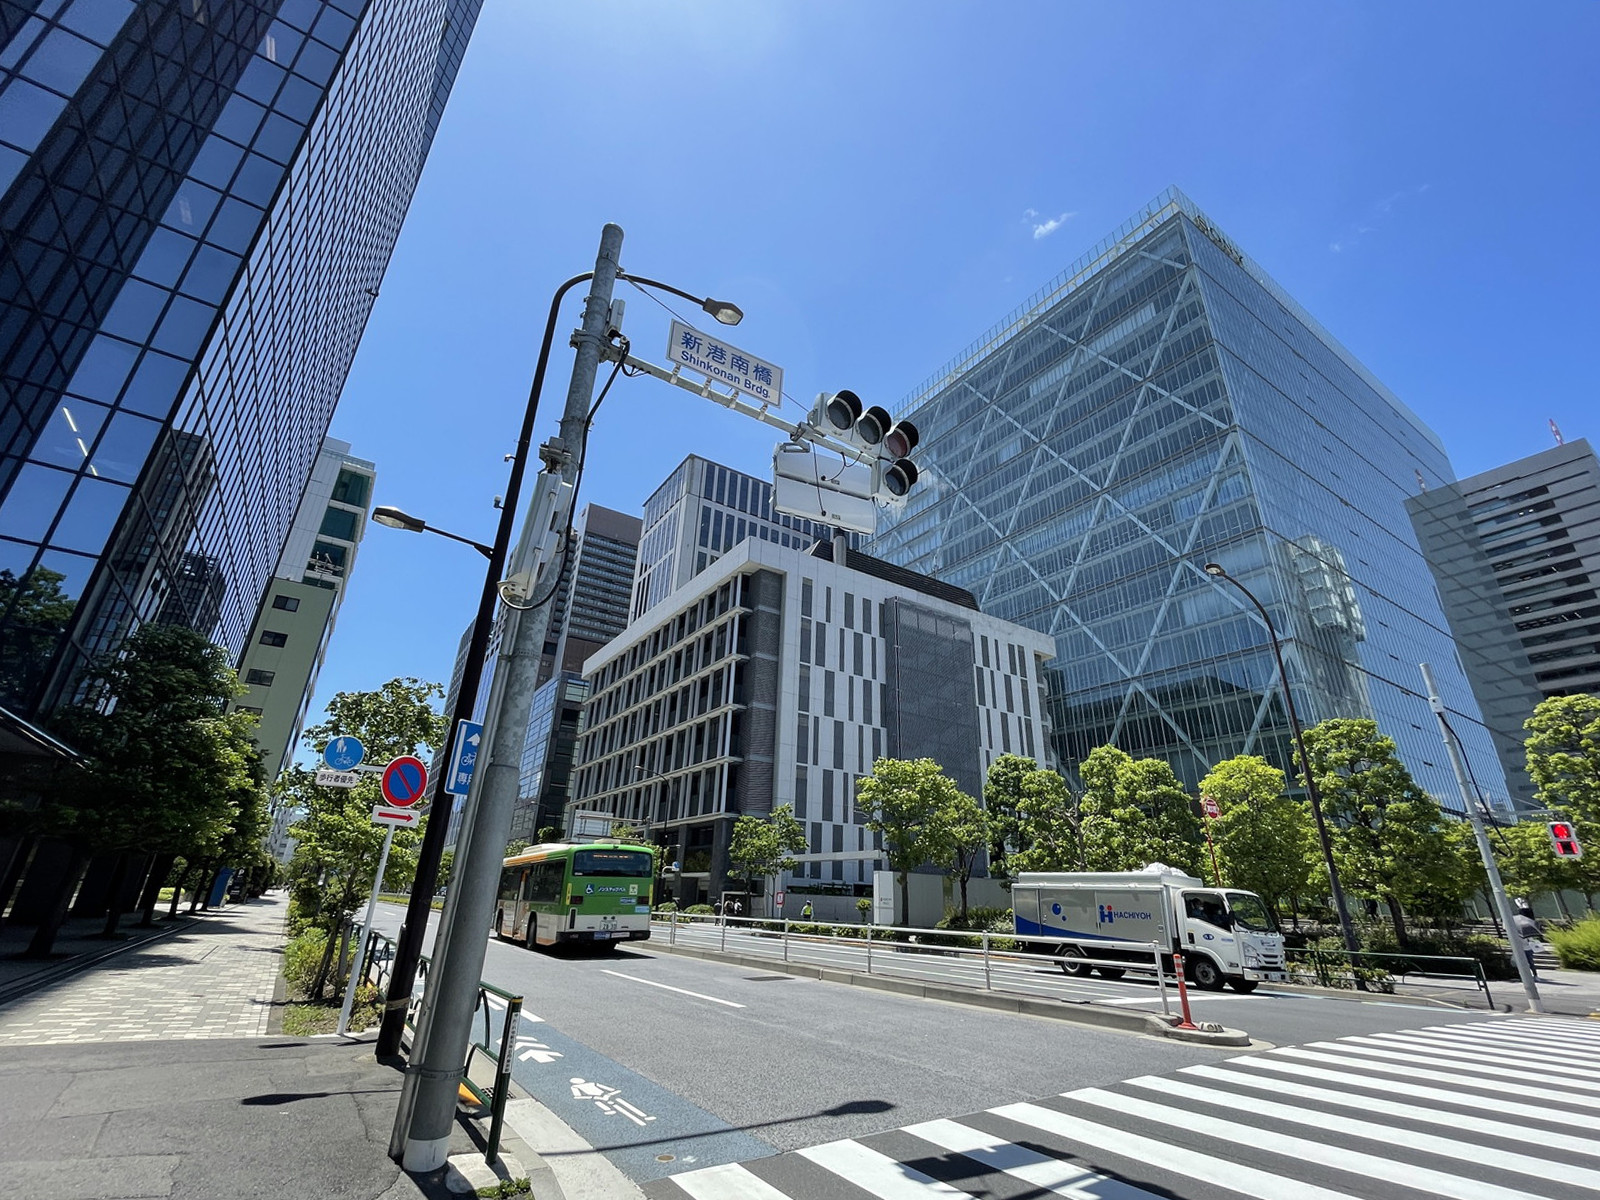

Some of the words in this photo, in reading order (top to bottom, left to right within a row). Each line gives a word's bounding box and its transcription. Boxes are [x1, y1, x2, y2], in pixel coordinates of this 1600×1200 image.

[681, 331, 773, 386] 新港南橋
[681, 350, 740, 385] Shinkonan
[744, 379, 771, 399] Brdg.
[319, 773, 354, 784] 歩行者優先
[1113, 911, 1152, 920] HACHIYOH
